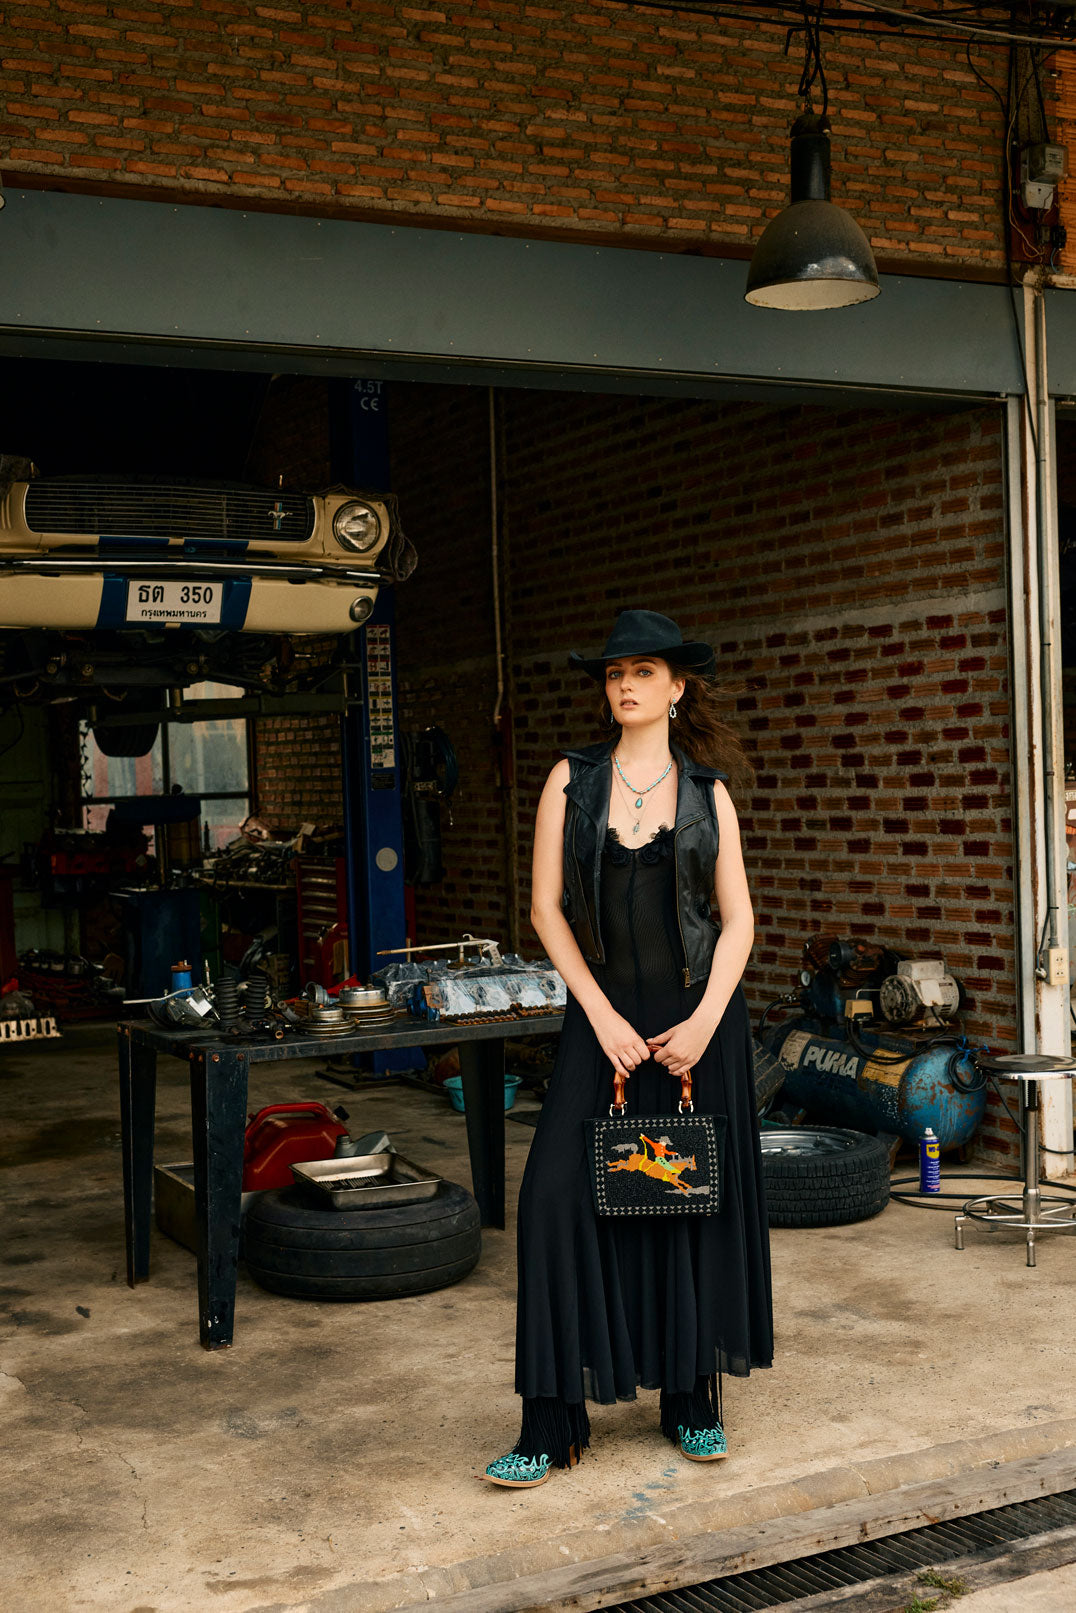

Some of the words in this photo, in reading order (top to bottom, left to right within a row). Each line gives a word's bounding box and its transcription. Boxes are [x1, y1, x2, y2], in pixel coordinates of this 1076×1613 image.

[355, 380, 383, 395] 4.5T
[360, 397, 379, 411] CE
[138, 585, 164, 603] ธต
[180, 586, 213, 604] 350
[141, 609, 207, 620] กรุงเทพมหานคร
[803, 1046, 859, 1079] PUMA
